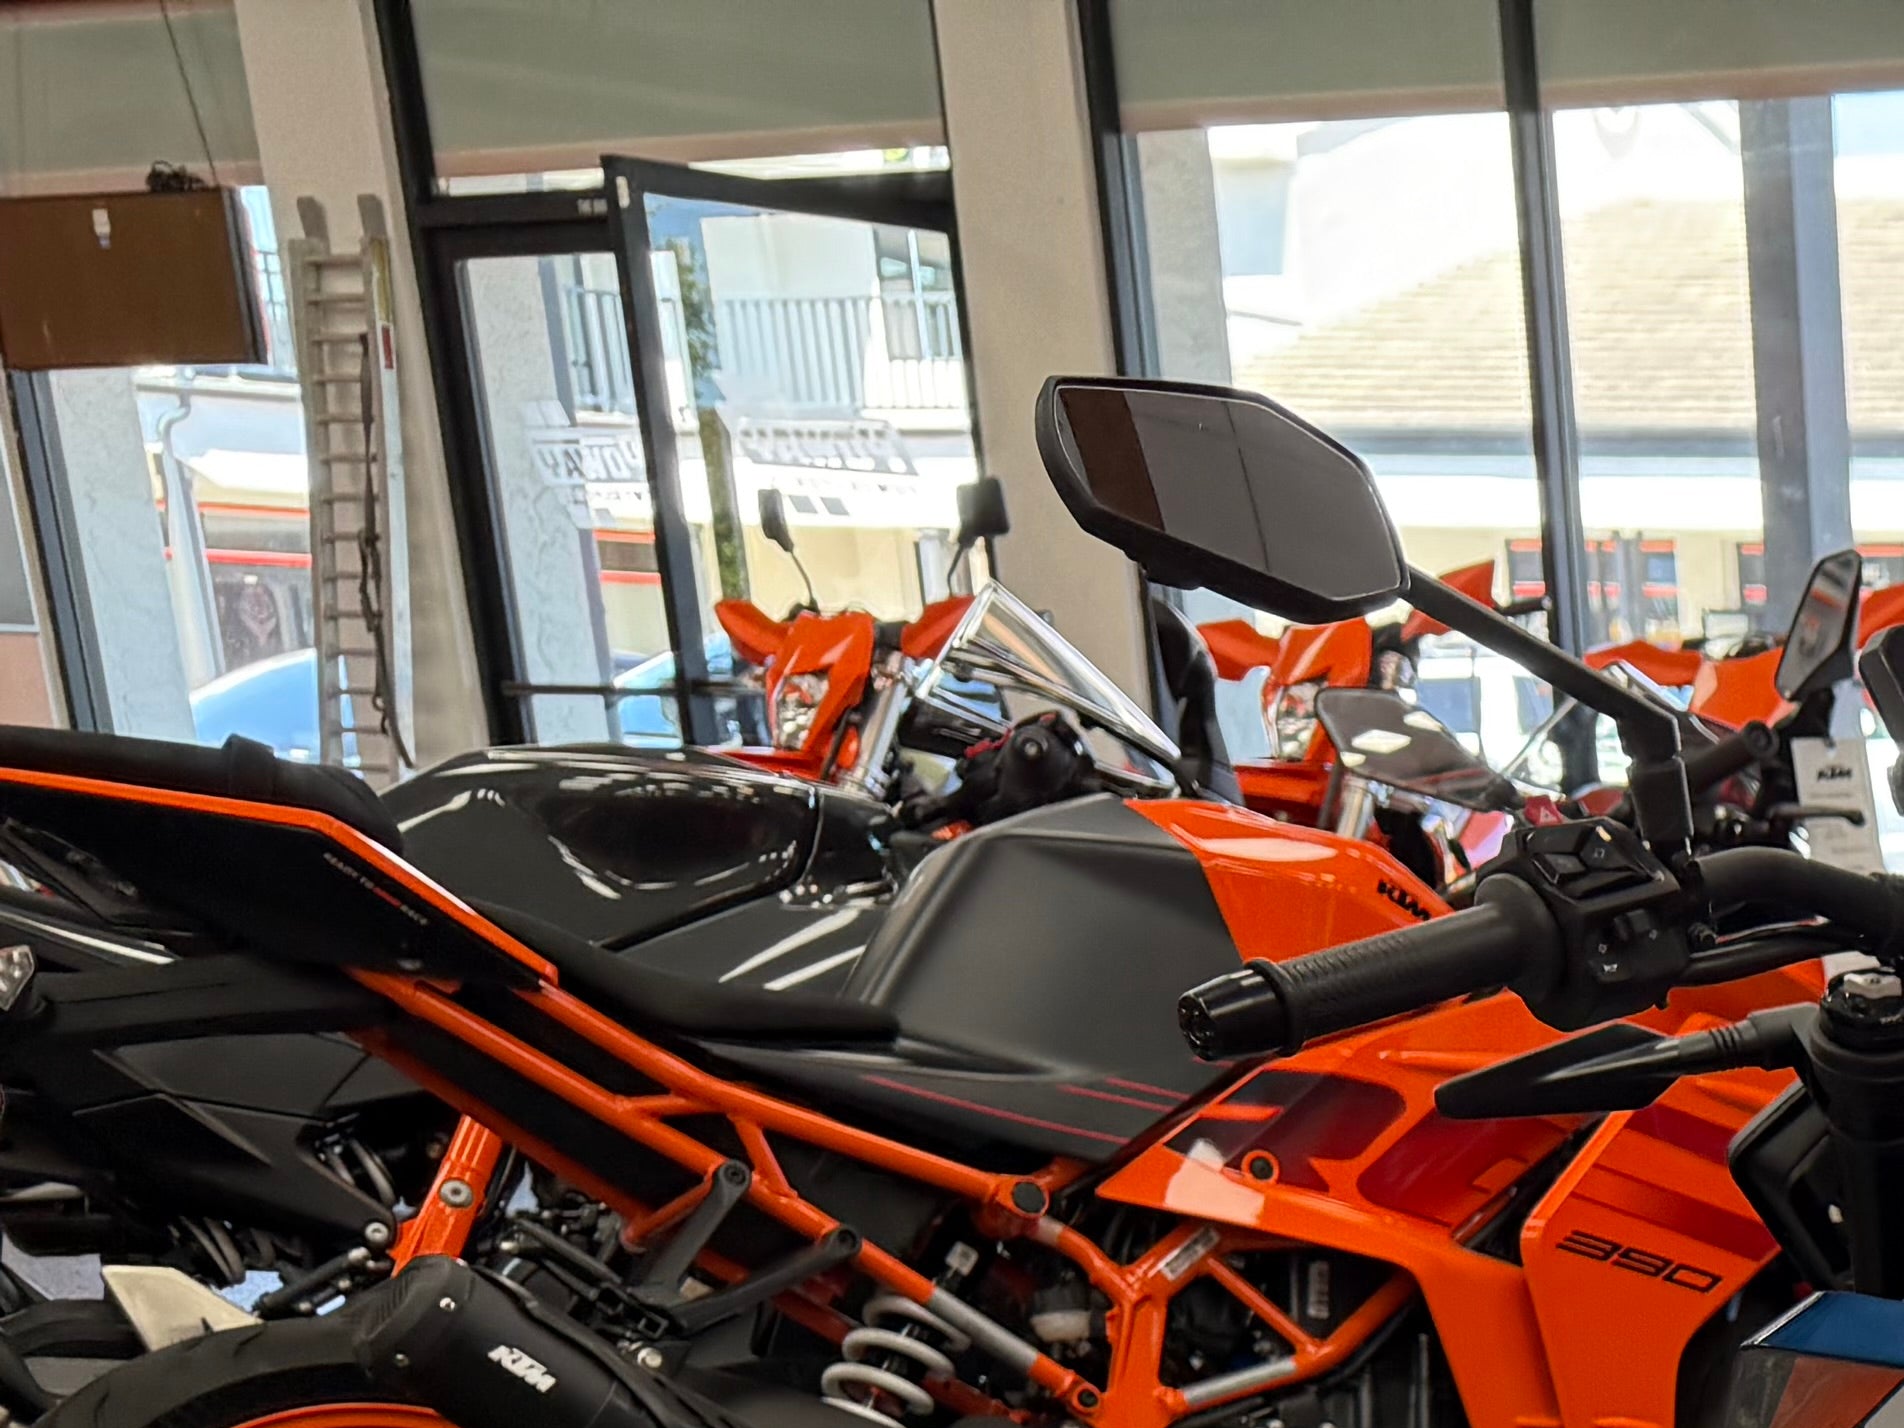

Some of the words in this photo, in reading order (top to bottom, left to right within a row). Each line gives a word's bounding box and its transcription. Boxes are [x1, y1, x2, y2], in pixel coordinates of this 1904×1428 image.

[1378, 879, 1431, 920] KTM
[1555, 1229, 1723, 1294] 390
[487, 1344, 556, 1393] KTM
